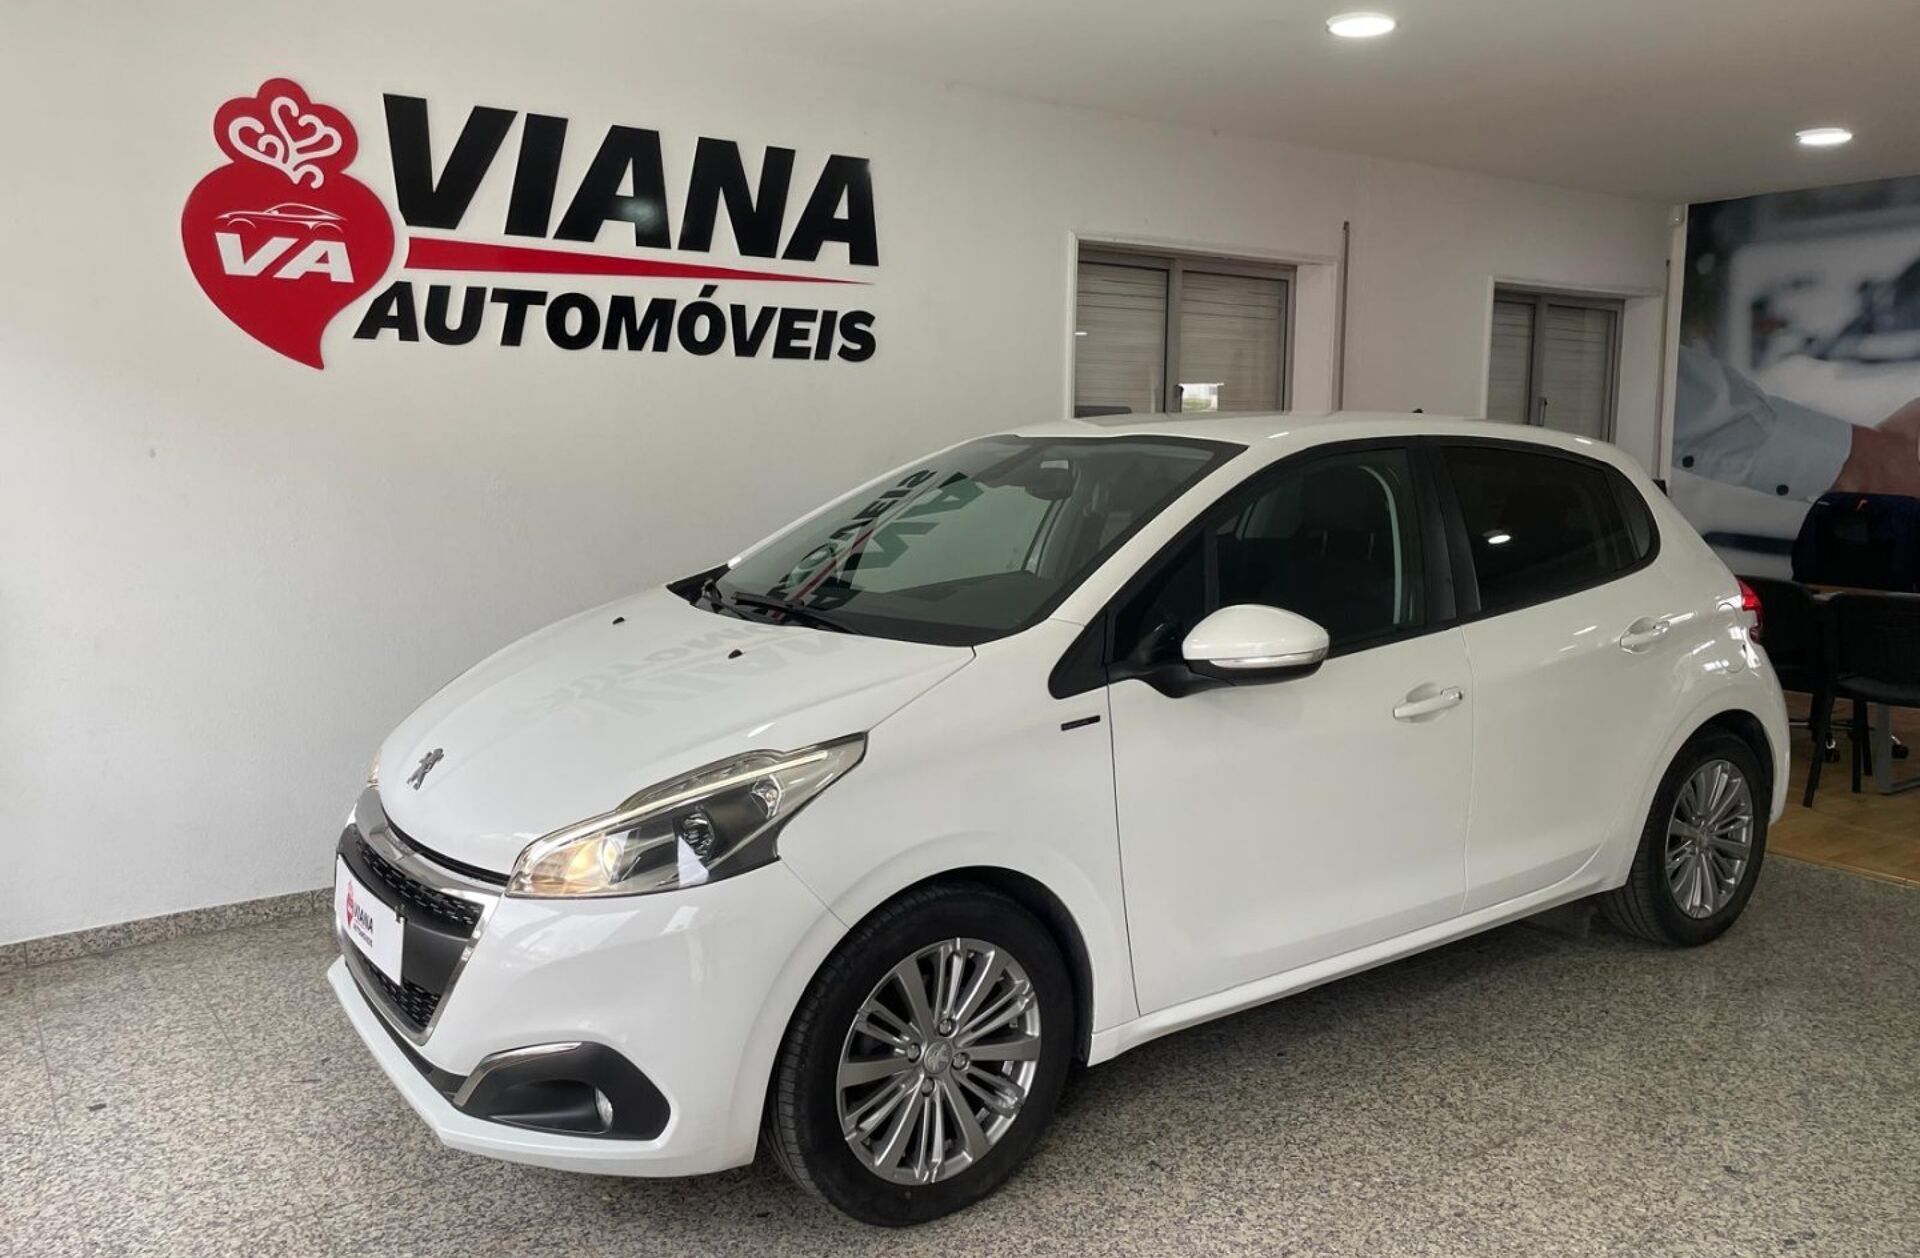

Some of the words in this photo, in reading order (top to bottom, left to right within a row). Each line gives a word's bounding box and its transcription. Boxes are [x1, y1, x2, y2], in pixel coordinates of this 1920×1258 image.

[383, 93, 880, 267] VIANA
[215, 232, 355, 283] VA
[353, 280, 877, 363] AUTOMÓVEIS
